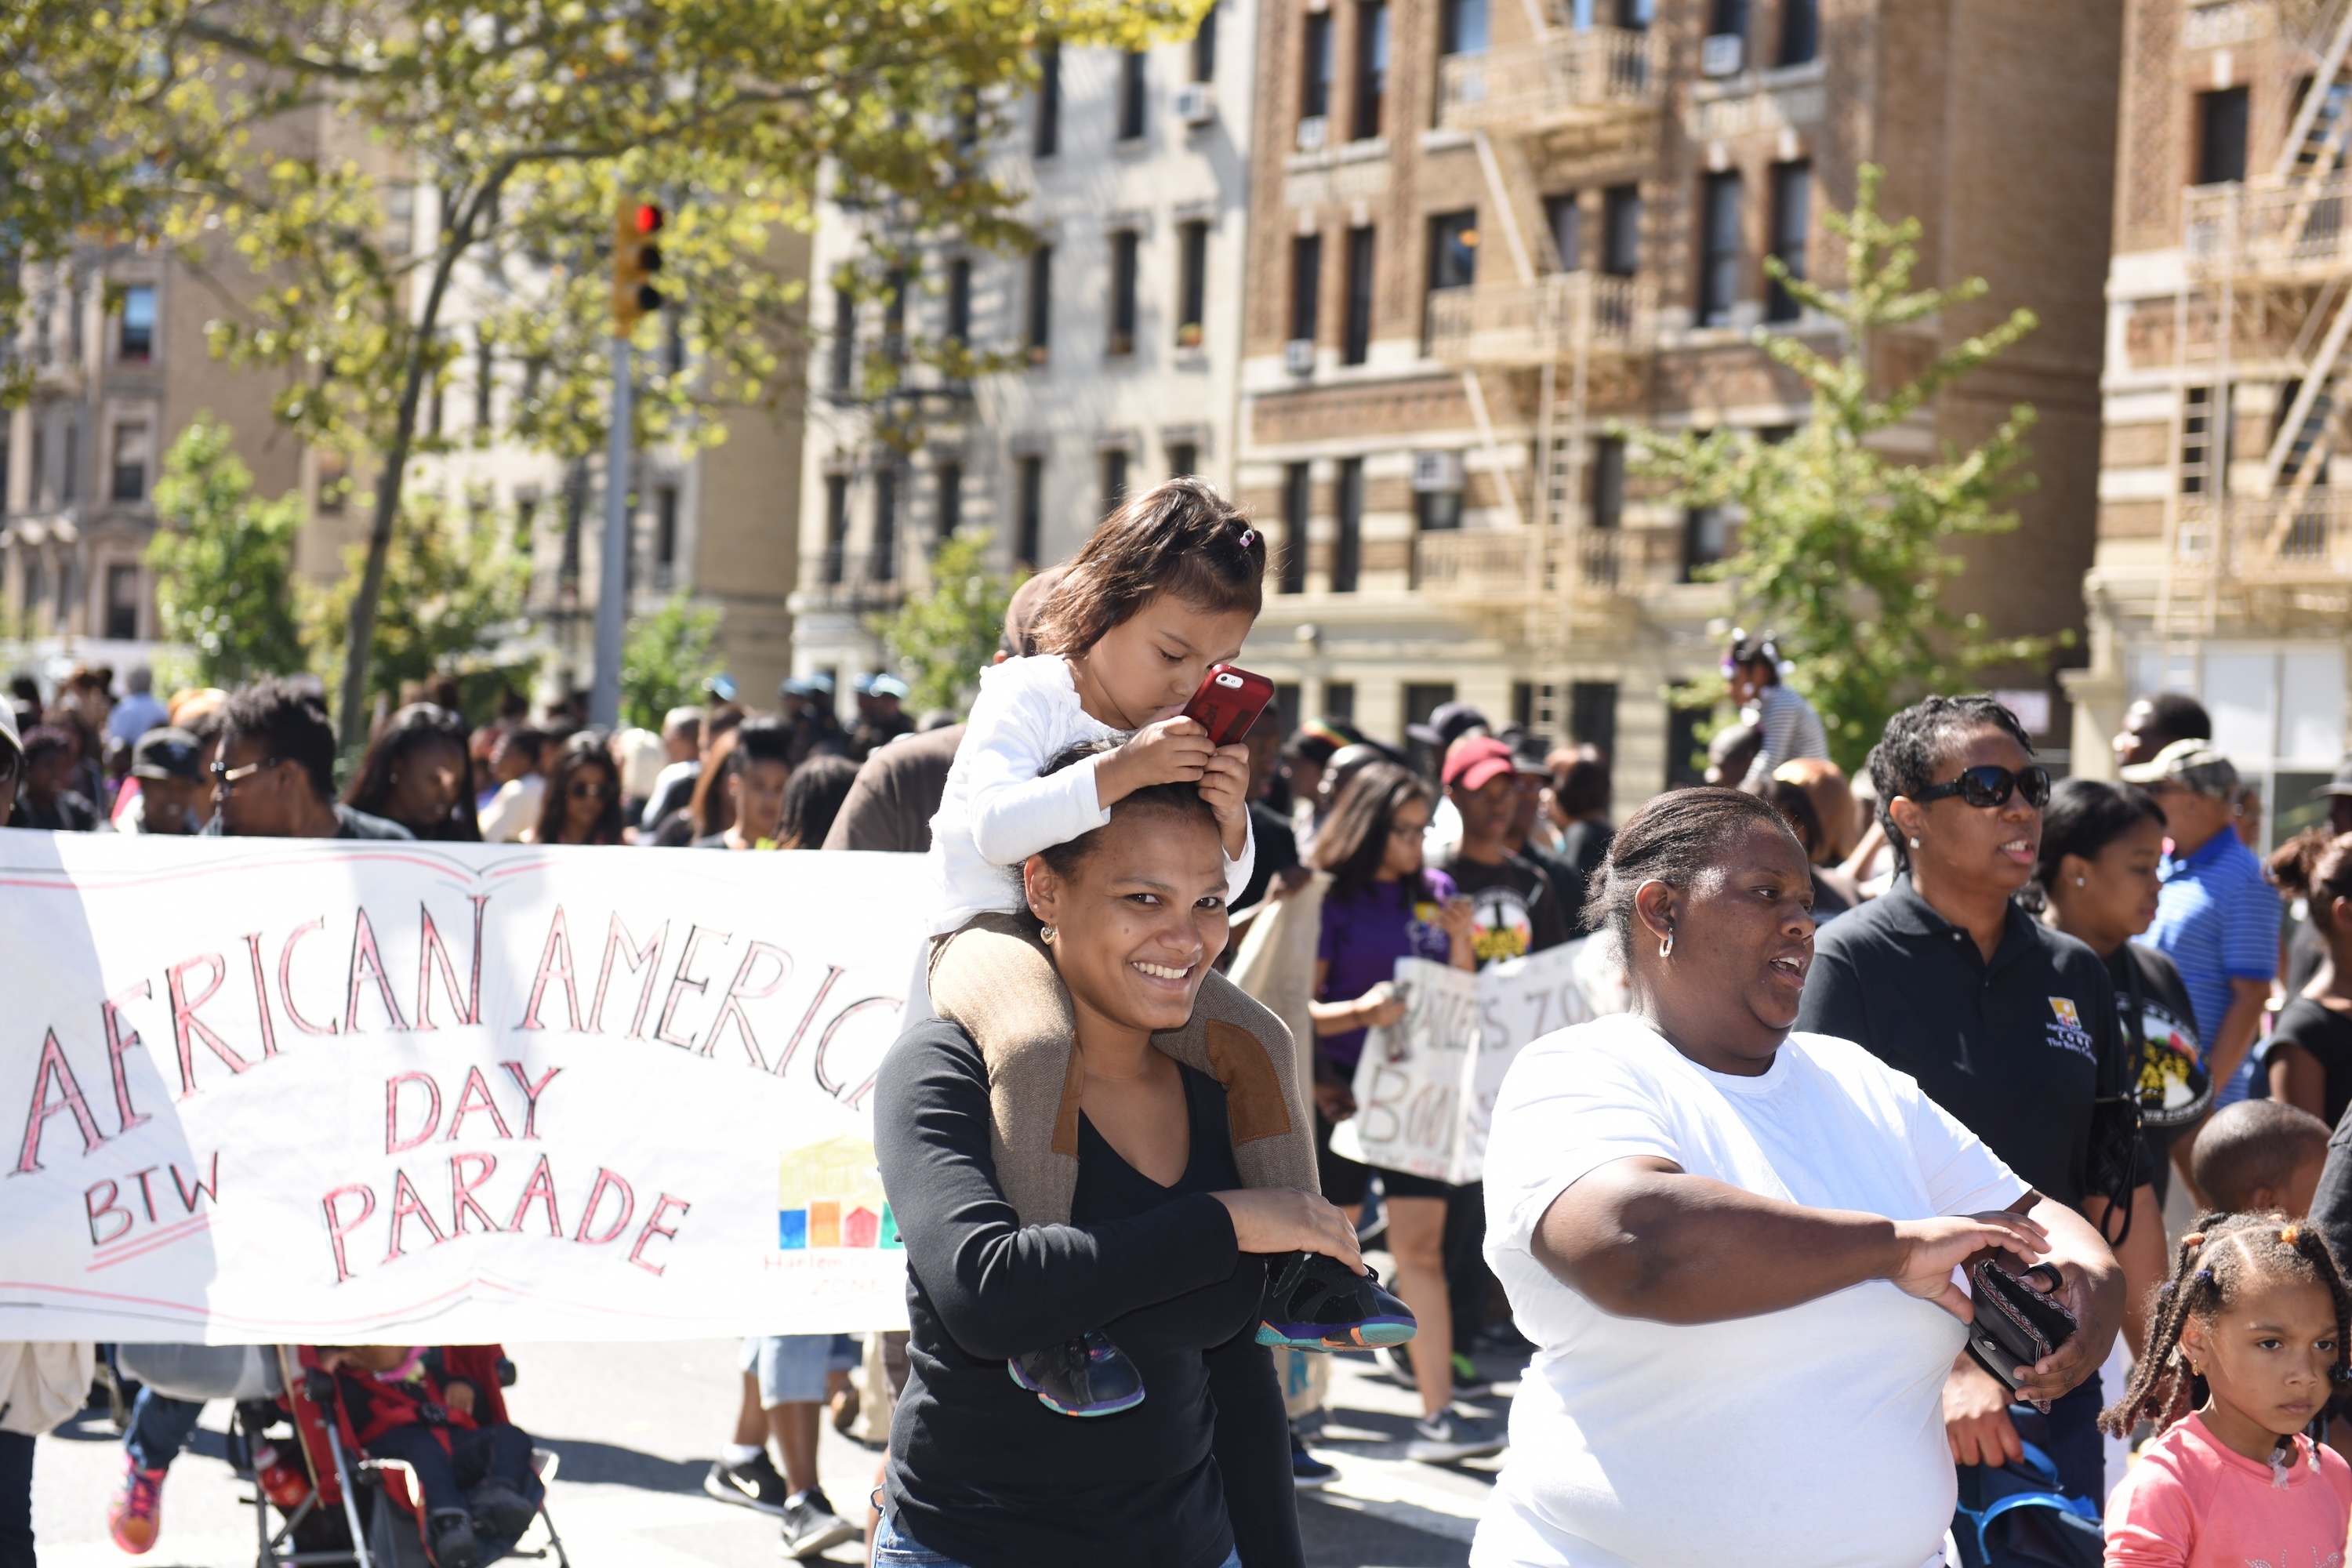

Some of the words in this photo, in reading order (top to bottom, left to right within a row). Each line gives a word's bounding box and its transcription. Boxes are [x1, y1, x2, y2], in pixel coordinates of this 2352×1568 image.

[6, 895, 489, 1176] AFRICAN
[387, 1061, 566, 1155] DAY
[84, 1150, 219, 1247] BTW
[322, 1152, 691, 1284] PARADE
[763, 1254, 843, 1272] Harlem
